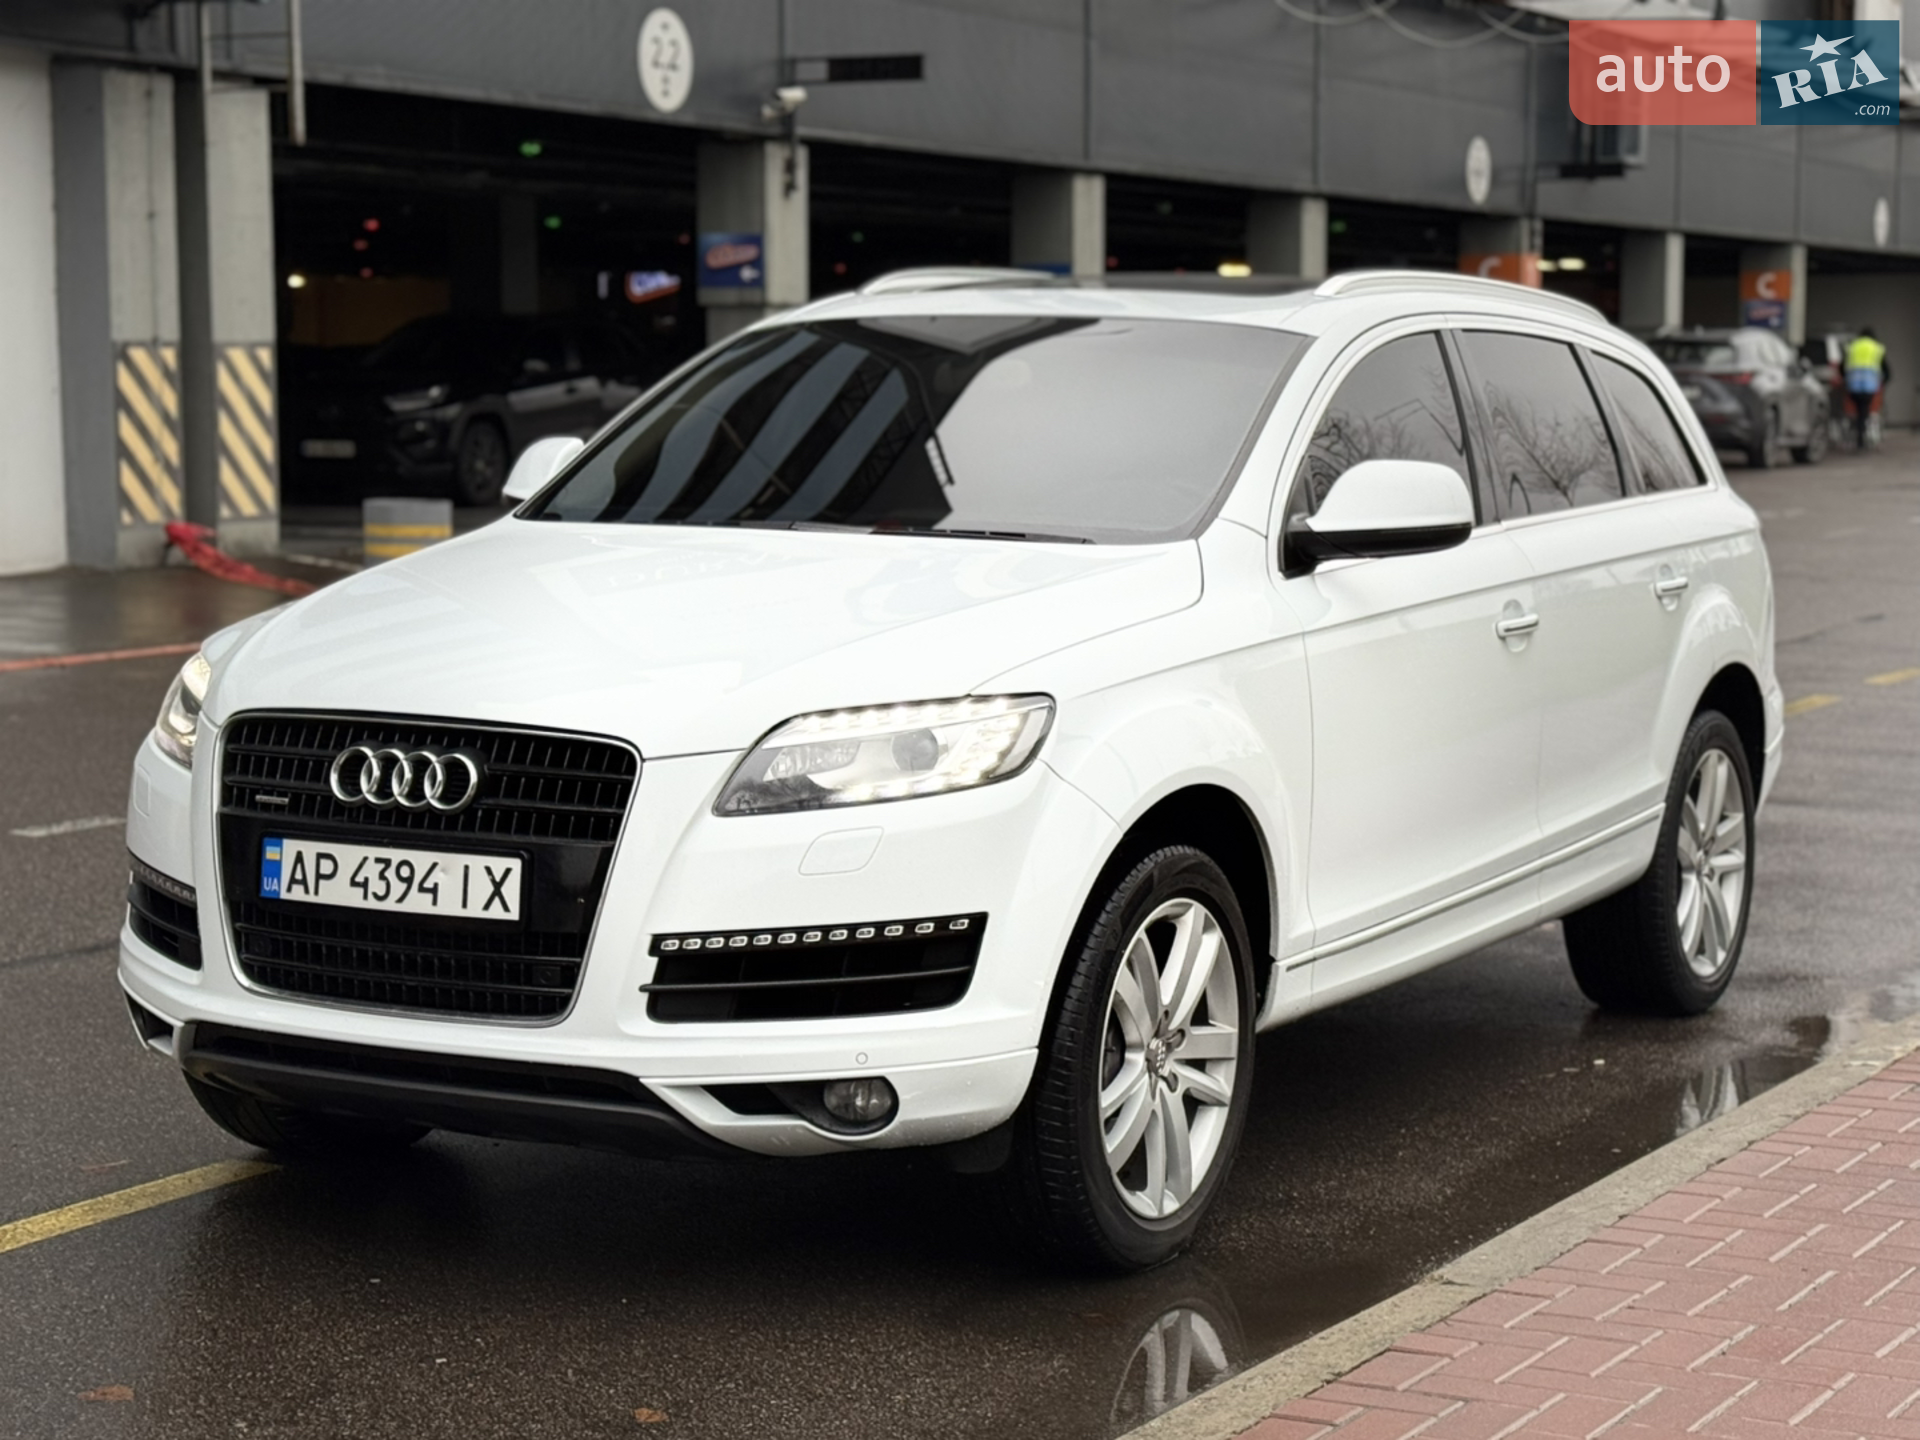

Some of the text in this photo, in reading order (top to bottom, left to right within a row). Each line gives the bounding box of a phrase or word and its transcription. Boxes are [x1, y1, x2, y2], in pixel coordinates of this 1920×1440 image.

[1756, 272, 1777, 300] C
[263, 877, 280, 892] UA
[286, 850, 514, 914] AP 4394 IX
